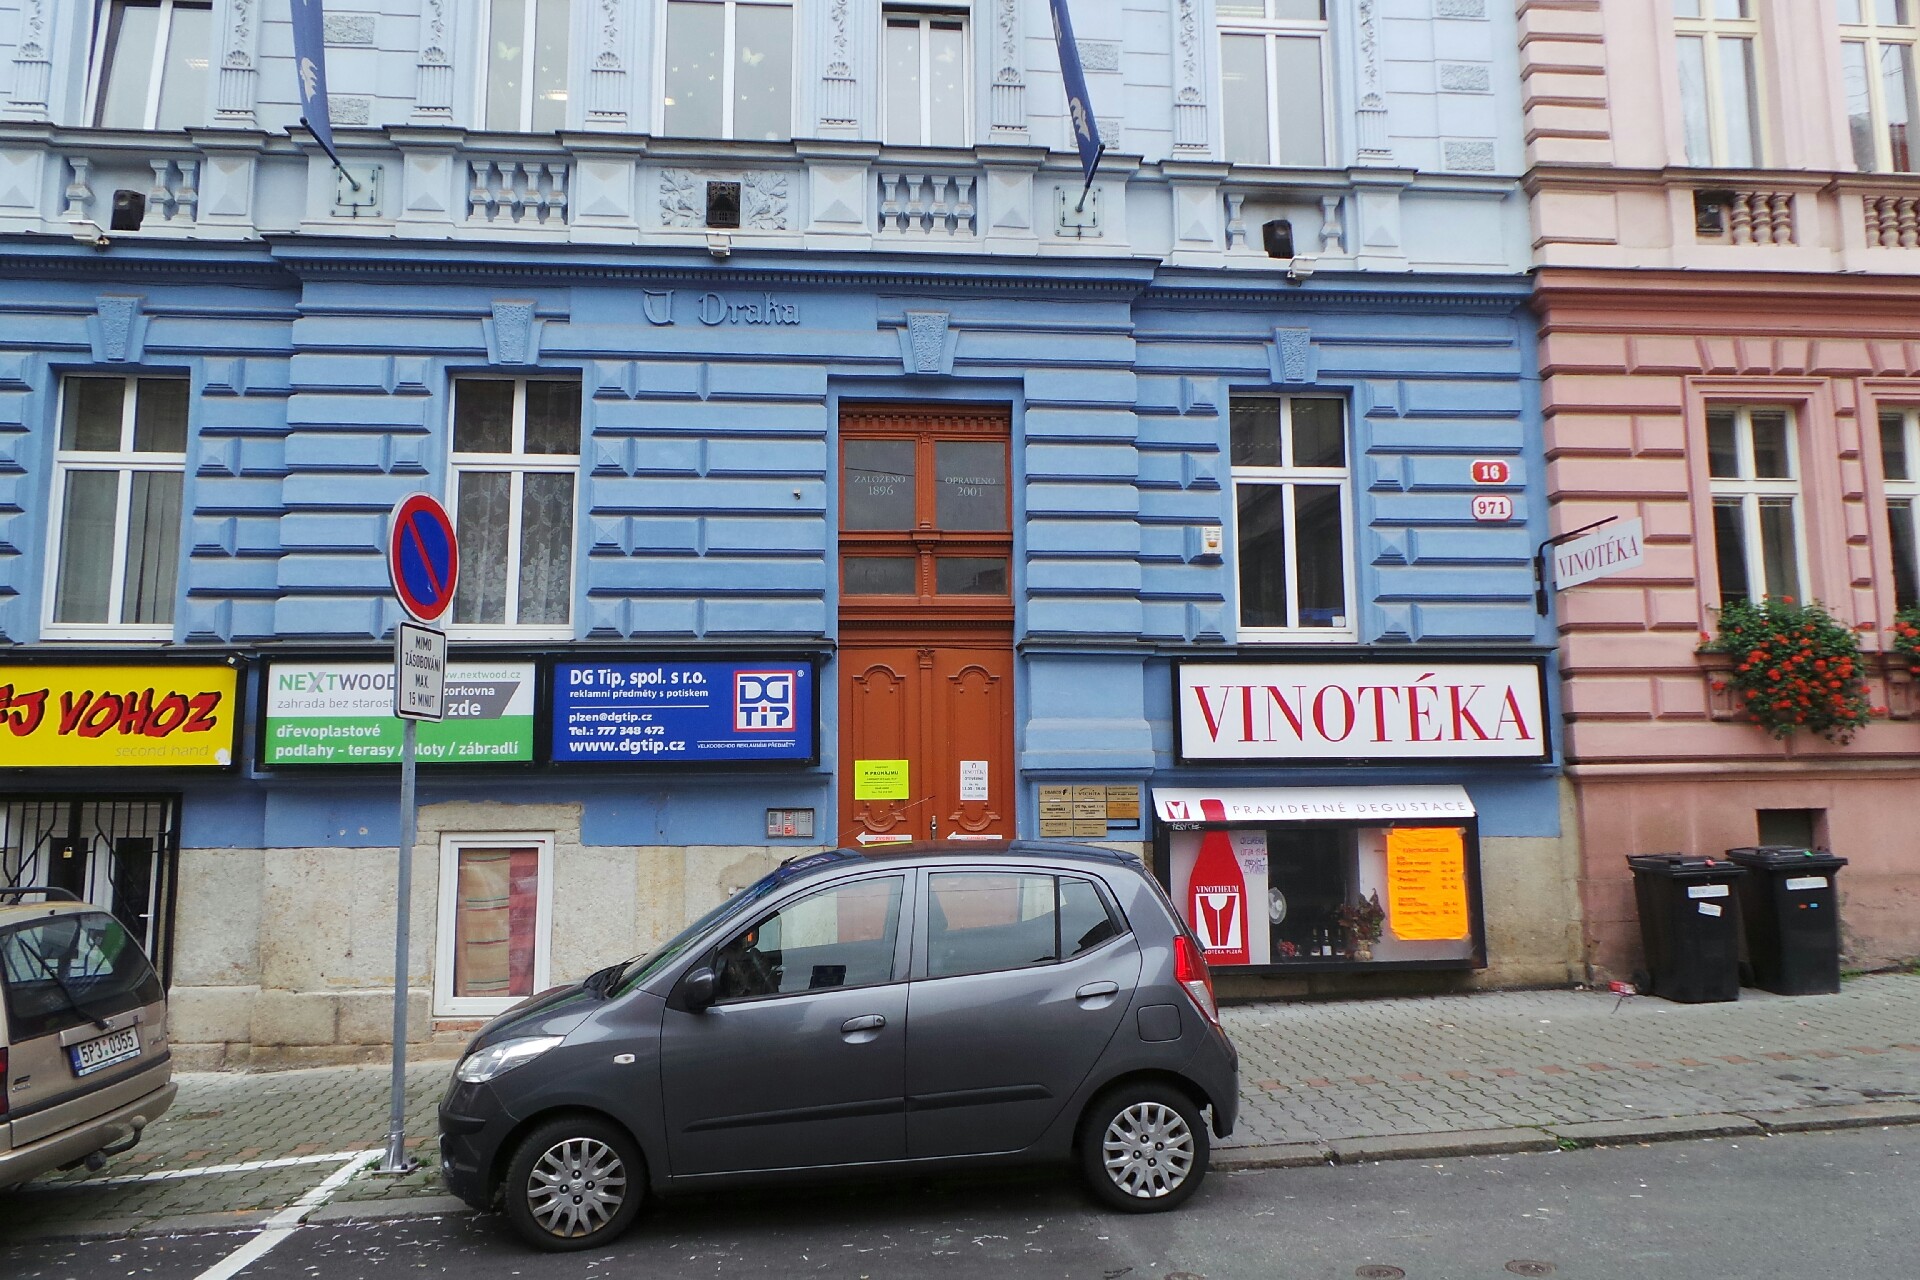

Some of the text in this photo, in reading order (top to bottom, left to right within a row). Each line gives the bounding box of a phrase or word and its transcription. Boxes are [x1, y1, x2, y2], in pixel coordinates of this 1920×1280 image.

[698, 291, 800, 326] Draka
[945, 476, 996, 485] OPRAVENO
[1481, 465, 1500, 480] 16
[868, 485, 894, 496] 1896
[957, 486, 983, 497] 2001
[1478, 501, 1505, 515] 971
[1558, 535, 1639, 577] VINOTÉKA
[415, 635, 432, 651] MIMO
[405, 650, 441, 672] ZÁSOBOVÁNÍ
[570, 668, 707, 688] DG Tip, spol. s r.o.
[409, 691, 435, 708] 15 MINUT
[569, 689, 611, 698] reklamní
[612, 689, 657, 700] předměty
[666, 688, 709, 699] potiskem
[277, 698, 325, 709] zahrada
[329, 698, 349, 709] bez
[447, 699, 481, 716] zde
[1190, 672, 1535, 743] VINOTÉKA
[58, 687, 222, 738] VOHOZ
[569, 712, 653, 723] plzen@dgtip.cz
[276, 724, 381, 740] dřevoplastové
[569, 726, 665, 736] Tel.: 777 348 472
[115, 744, 208, 757] second hand
[275, 744, 334, 759] podlahy
[348, 744, 395, 758] terasy
[415, 743, 445, 757] loty
[458, 741, 519, 756] zábradlí
[569, 738, 686, 754] www.dgtip.cz
[1232, 801, 1467, 815] PRAVIDELNÉ DEGUSTACE
[1195, 885, 1240, 894] VINOTHEUM
[81, 1041, 103, 1064] 5P3
[109, 1031, 133, 1054] 0355
